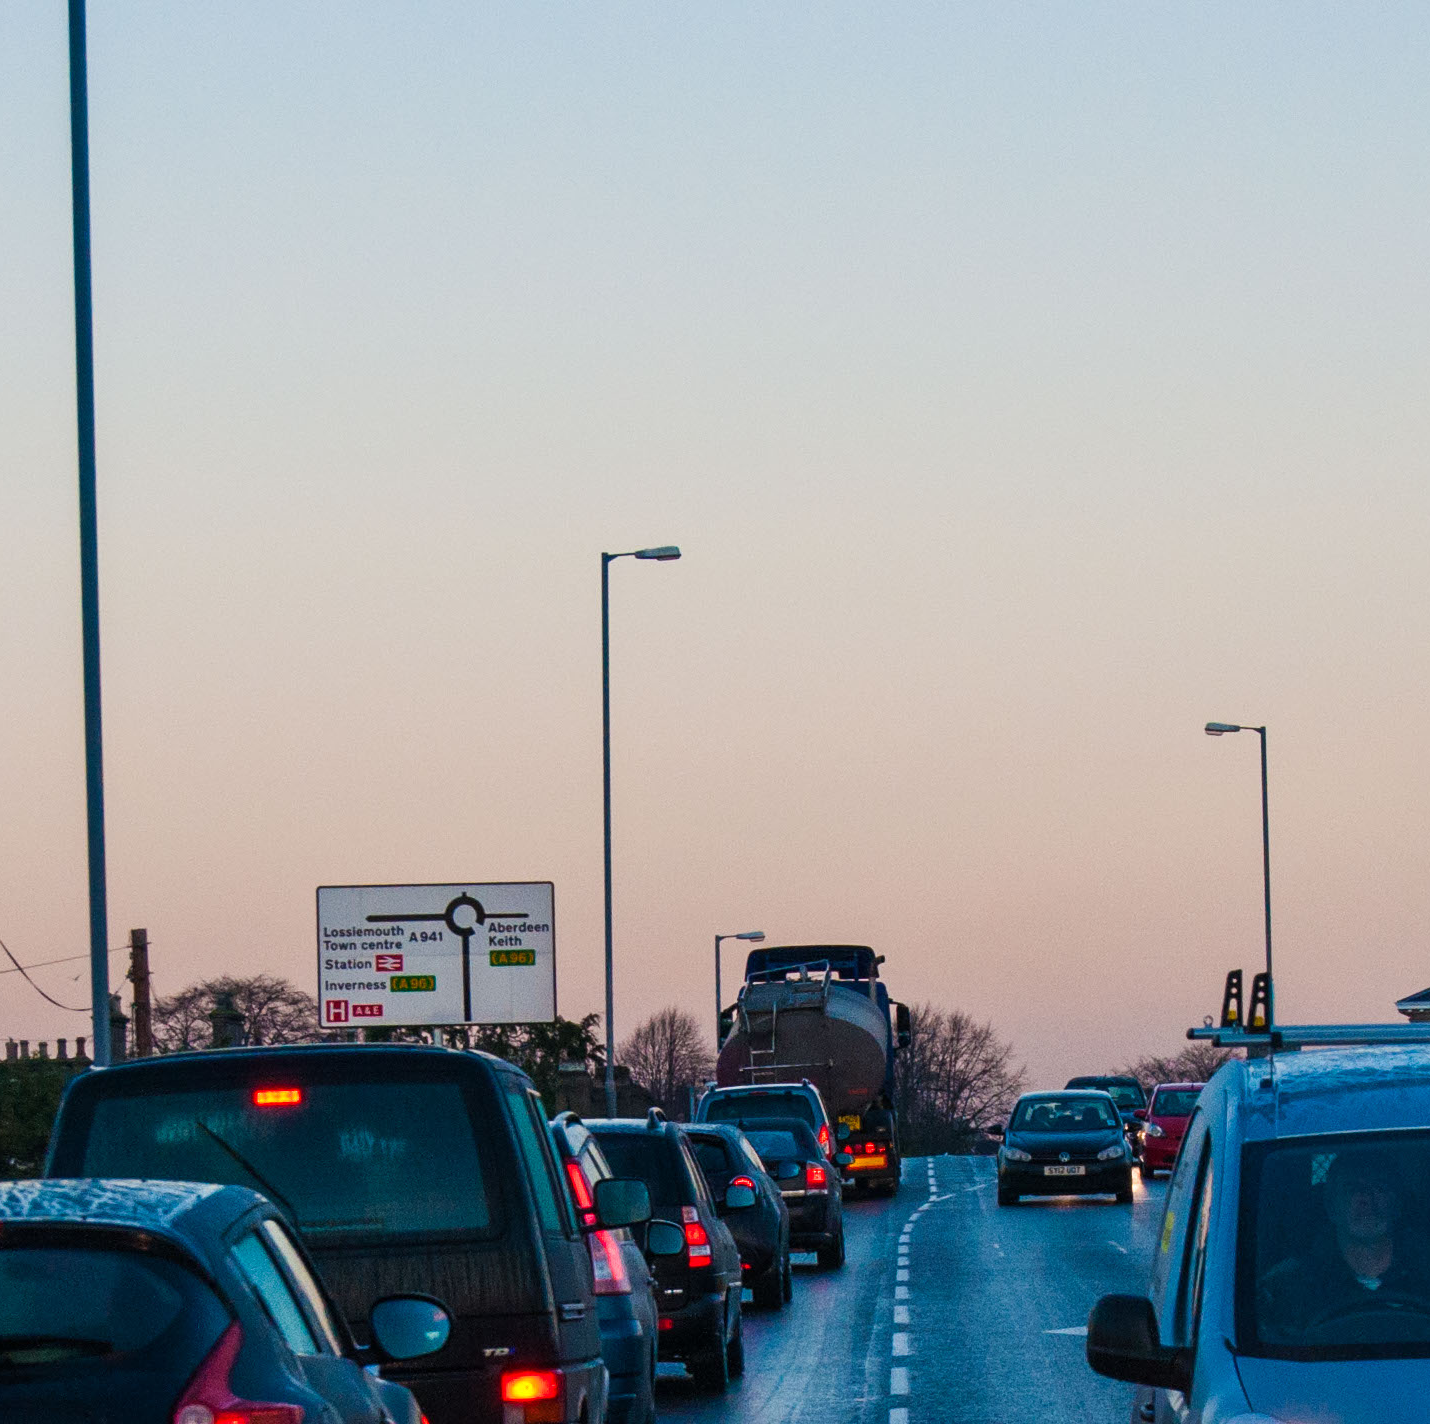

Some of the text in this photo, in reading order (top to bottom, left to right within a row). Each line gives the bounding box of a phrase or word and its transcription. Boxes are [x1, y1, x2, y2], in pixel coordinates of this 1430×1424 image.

[323, 925, 405, 938] Lossiemouth
[488, 922, 550, 933] Aberdeen
[323, 939, 403, 951] Town centre
[488, 935, 523, 947] Keith
[324, 958, 372, 971] Station
[325, 980, 387, 991] Inverness
